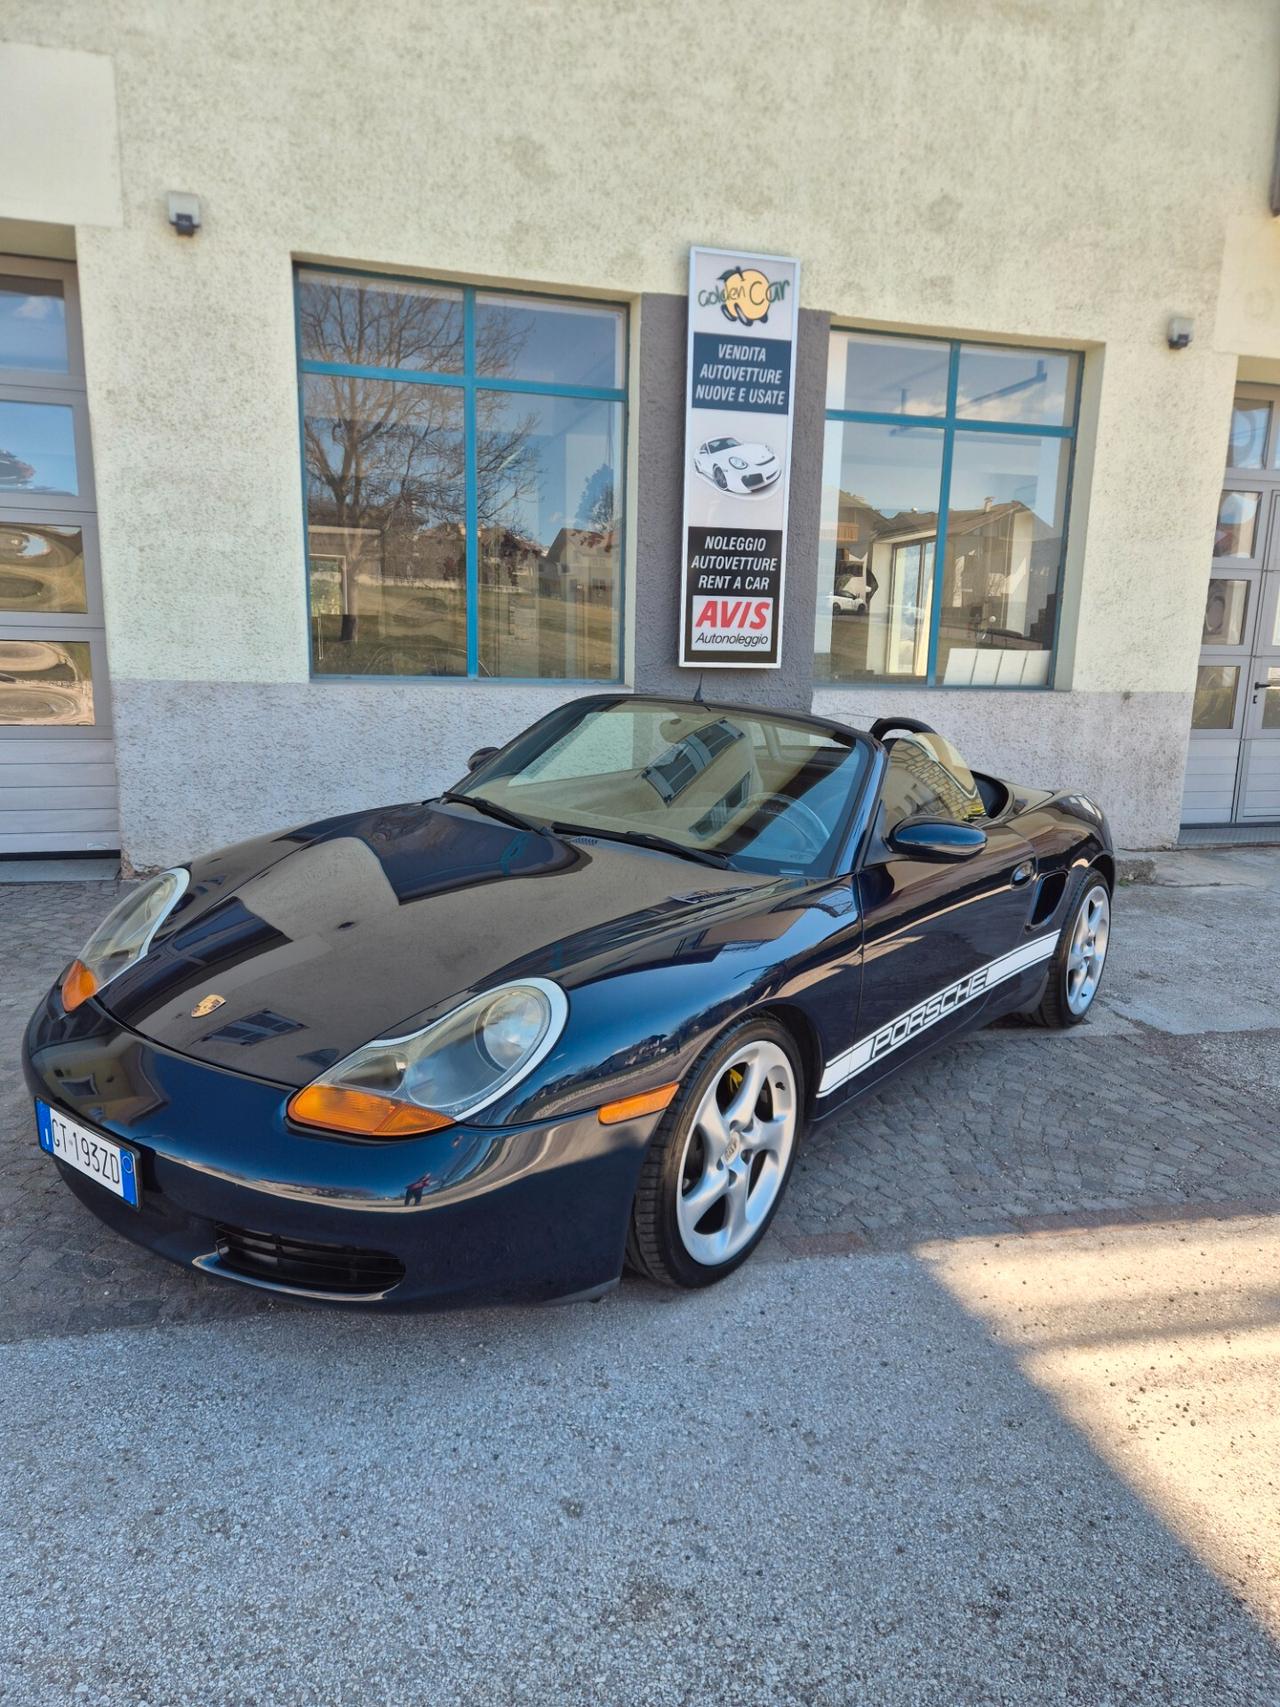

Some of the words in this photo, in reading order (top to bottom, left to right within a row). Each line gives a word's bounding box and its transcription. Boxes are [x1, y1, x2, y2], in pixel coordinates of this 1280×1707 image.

[698, 284, 746, 307] Golden
[750, 279, 790, 306] Car
[718, 344, 766, 362] VENDITA
[700, 364, 783, 385] AUTOVETTURE
[696, 384, 736, 401] NUOVE
[738, 388, 746, 402] E
[748, 389, 786, 406] USATE
[704, 536, 766, 551] NOLEGGIO
[691, 555, 777, 571] AUTOVETTURE
[698, 575, 732, 590] RENT
[733, 577, 742, 590] A
[745, 577, 770, 591] CAR
[695, 600, 771, 630] AVIS
[695, 632, 769, 648] Autonoleggio
[872, 968, 988, 1058] PORSCHE
